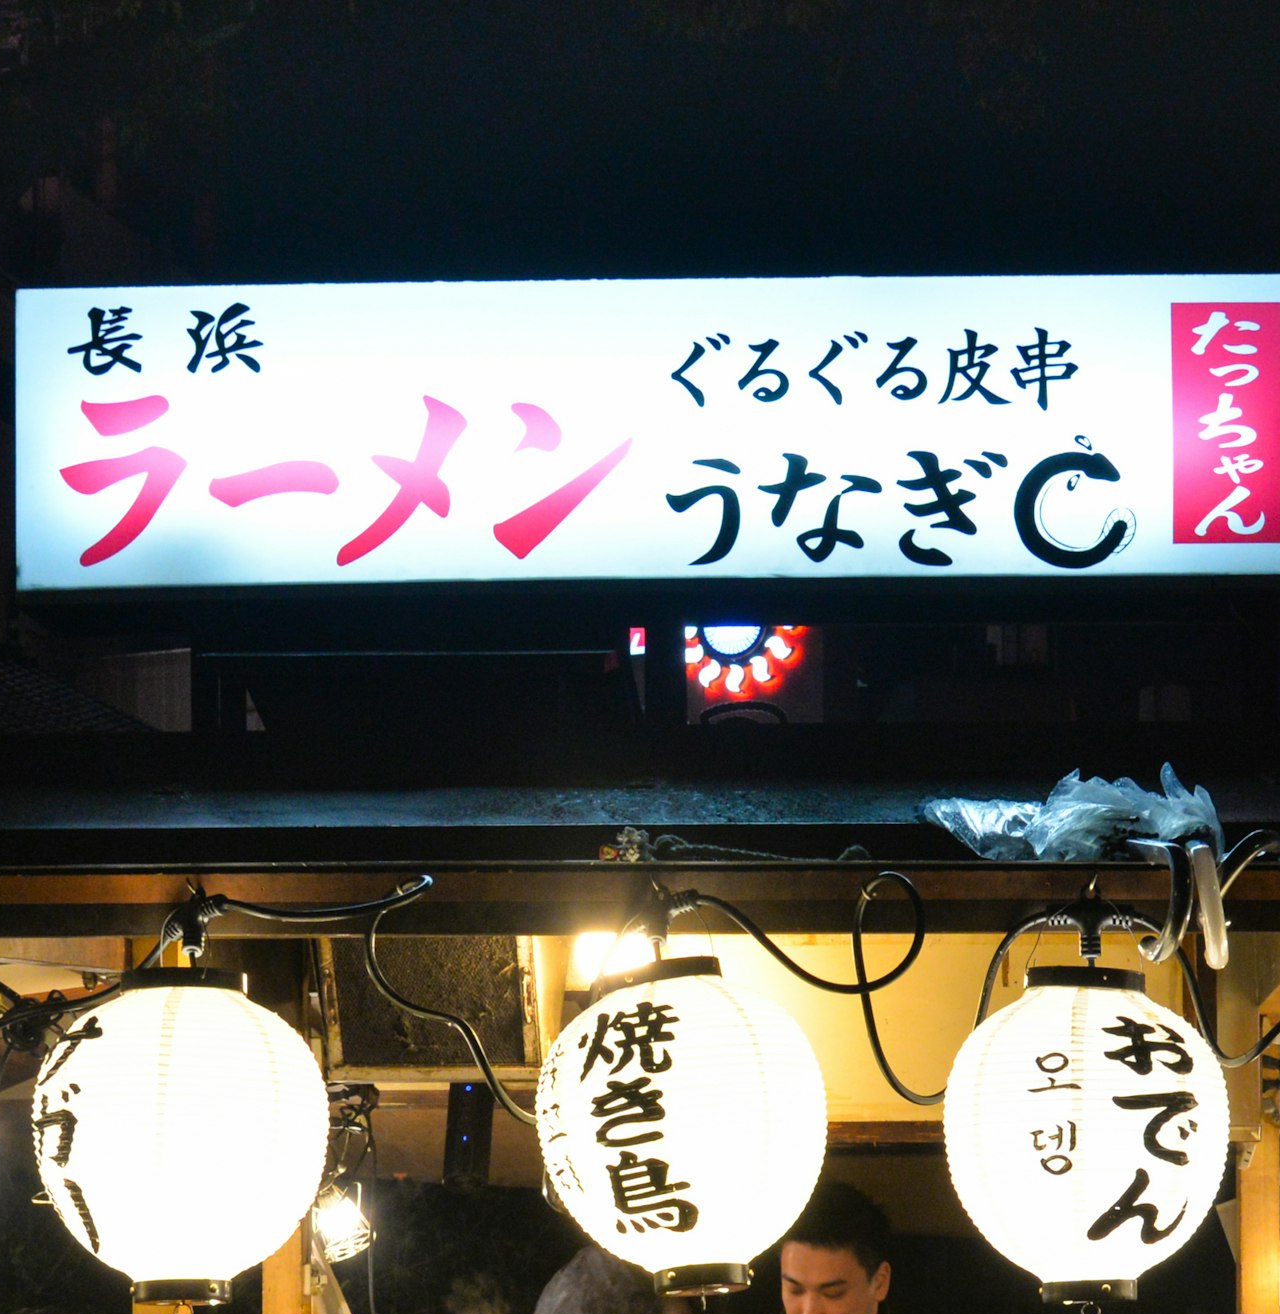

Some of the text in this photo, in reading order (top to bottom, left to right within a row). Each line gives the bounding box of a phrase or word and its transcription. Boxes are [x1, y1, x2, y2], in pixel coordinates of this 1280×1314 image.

[67, 303, 263, 376] 長浜
[671, 327, 1079, 411] ぐるぐる皮串
[60, 394, 634, 567] ラーメン
[1190, 311, 1266, 537] たっちゃん
[666, 450, 1008, 566] うなぎ
[578, 1002, 699, 1234] 焼き鳥
[1028, 1052, 1081, 1176] 오뎅
[1087, 1015, 1198, 1246] おでん
